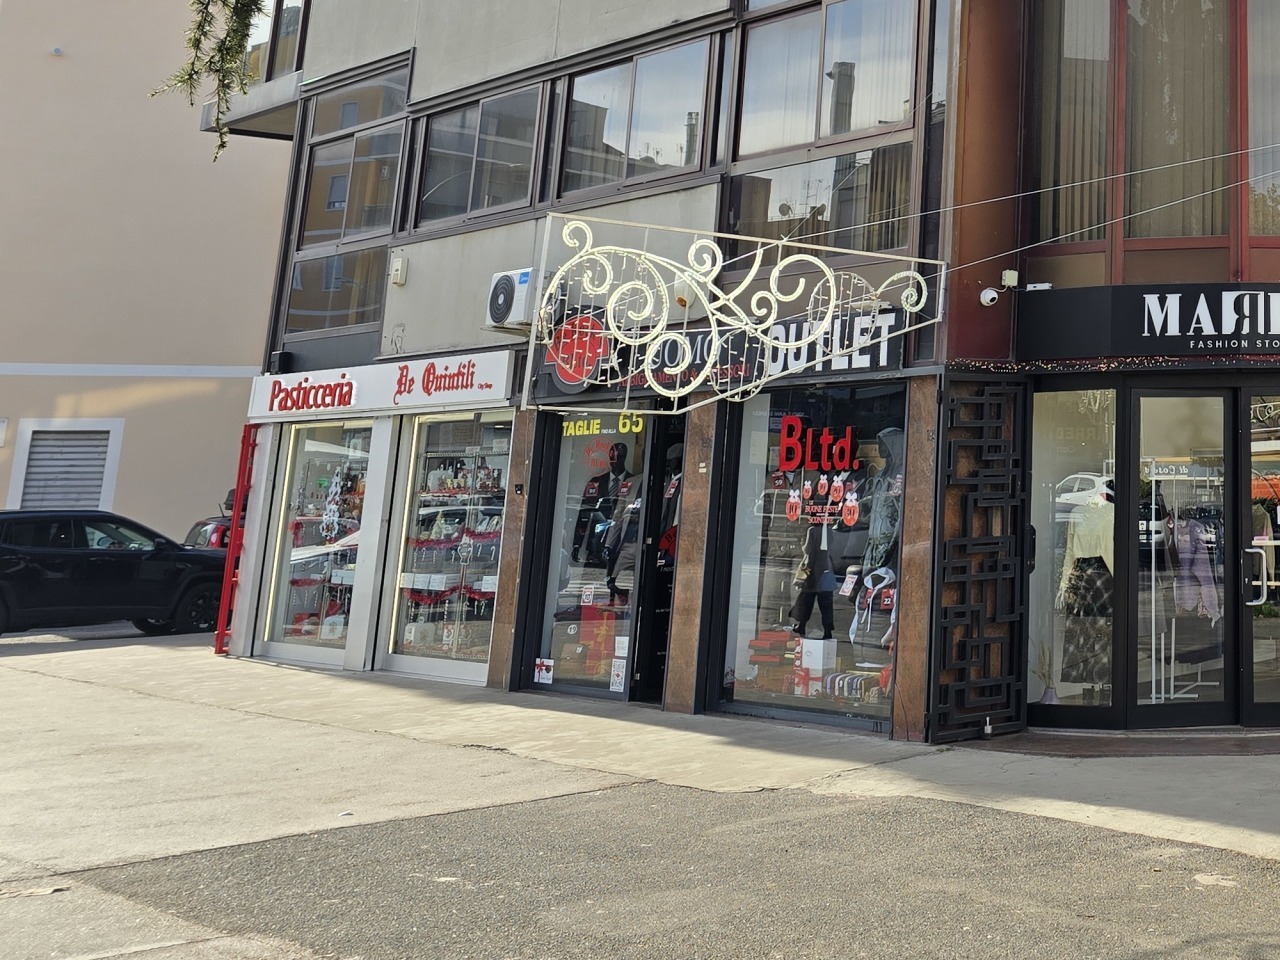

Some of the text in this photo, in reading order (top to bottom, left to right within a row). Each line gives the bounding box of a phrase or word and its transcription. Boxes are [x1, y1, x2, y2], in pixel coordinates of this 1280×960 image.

[767, 313, 895, 375] OUTLET
[1189, 339, 1249, 349] FASHION
[268, 372, 354, 412] Pasticceria
[562, 419, 601, 437] TAGLIE
[618, 410, 644, 434] 65
